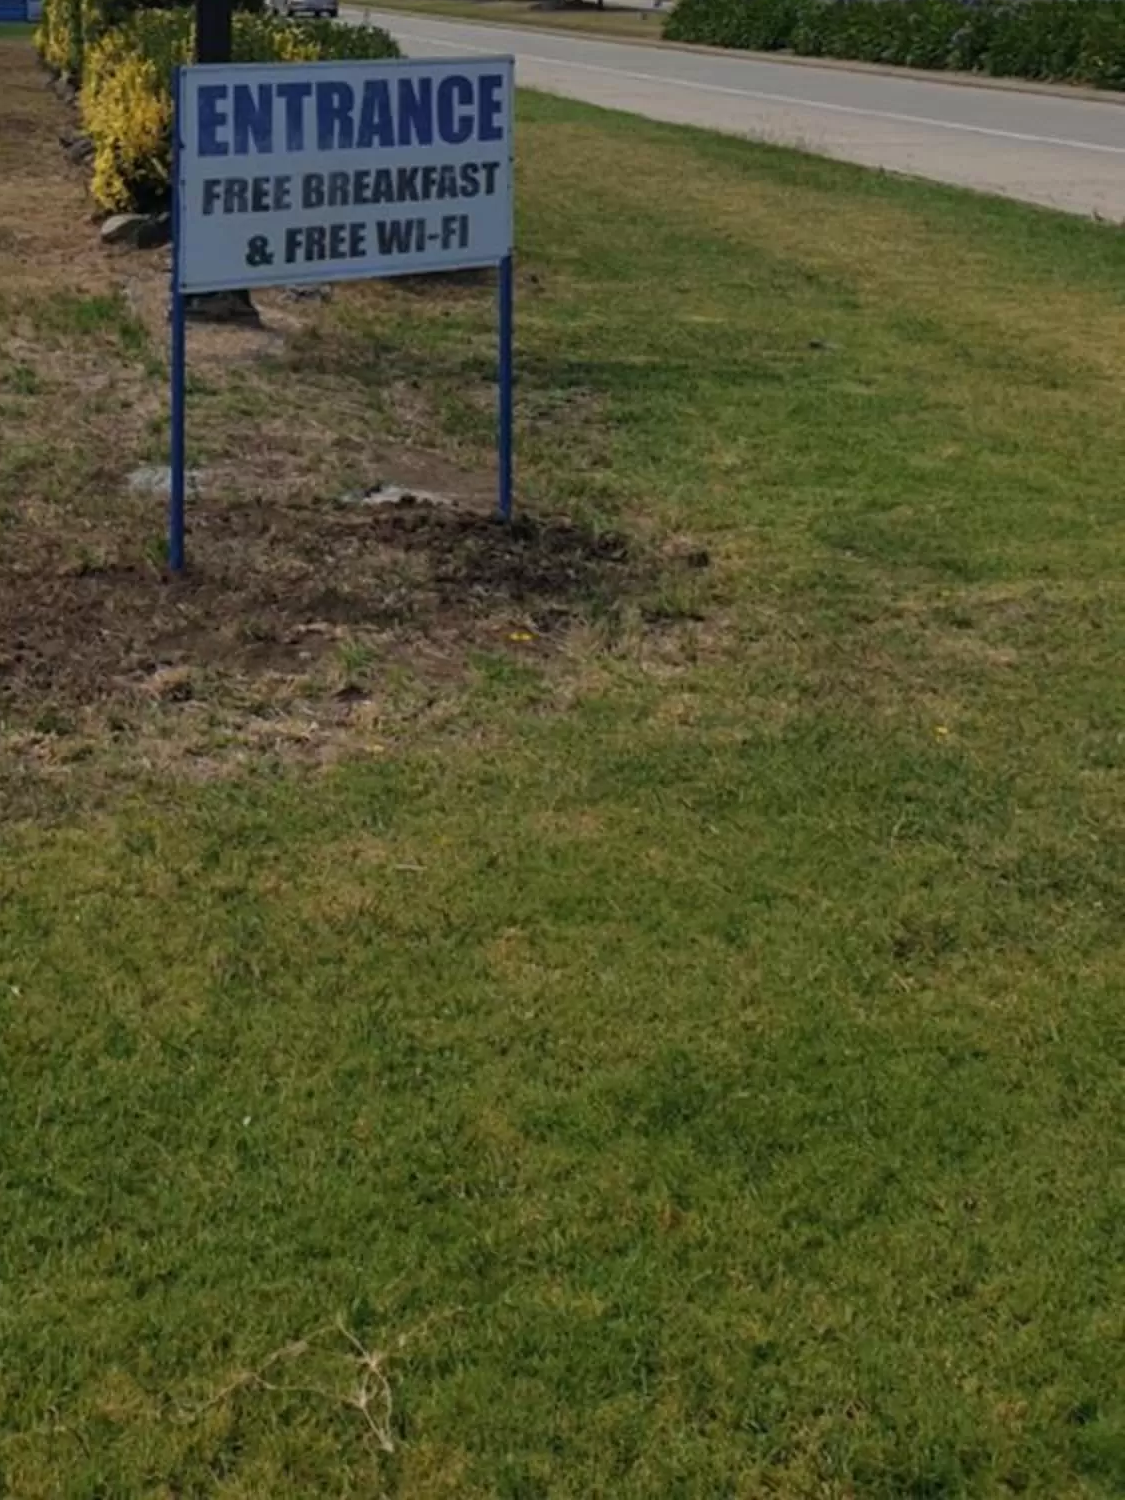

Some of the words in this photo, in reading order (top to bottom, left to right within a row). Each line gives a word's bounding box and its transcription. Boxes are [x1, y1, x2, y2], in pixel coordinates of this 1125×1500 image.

[196, 74, 504, 157] ENTRANCE
[202, 174, 293, 215] FREE
[301, 161, 501, 209] BREAKFAST
[245, 234, 274, 267] &
[284, 221, 367, 263] FREE
[376, 213, 470, 255] WI-FI
